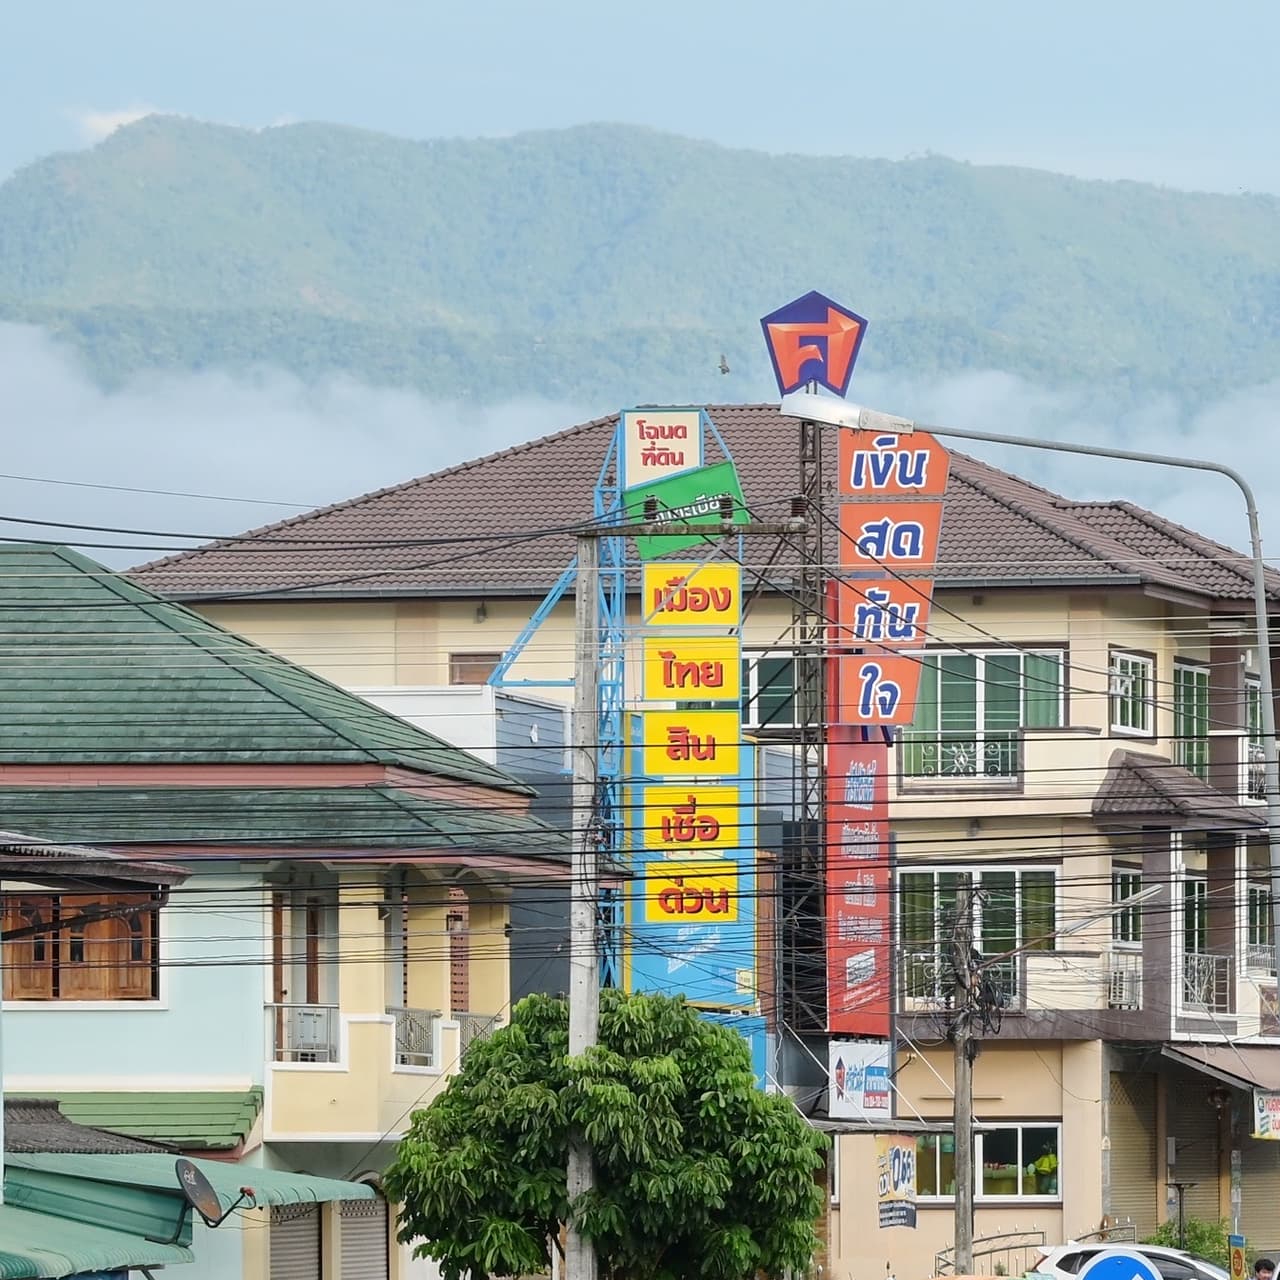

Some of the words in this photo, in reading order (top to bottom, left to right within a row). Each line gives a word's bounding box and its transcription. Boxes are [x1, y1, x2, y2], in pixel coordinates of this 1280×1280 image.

[636, 420, 688, 440] โฉนด
[641, 441, 685, 466] ที่ดิน
[850, 436, 928, 490] เงิน
[857, 518, 924, 559] สด
[653, 576, 731, 611] เมือง
[854, 587, 920, 642] ทัน
[658, 650, 723, 688] ไทย
[857, 664, 901, 718] ใจ
[665, 726, 716, 761] สิน
[661, 796, 720, 842] เชื่อ
[658, 875, 729, 914] ด่วน
